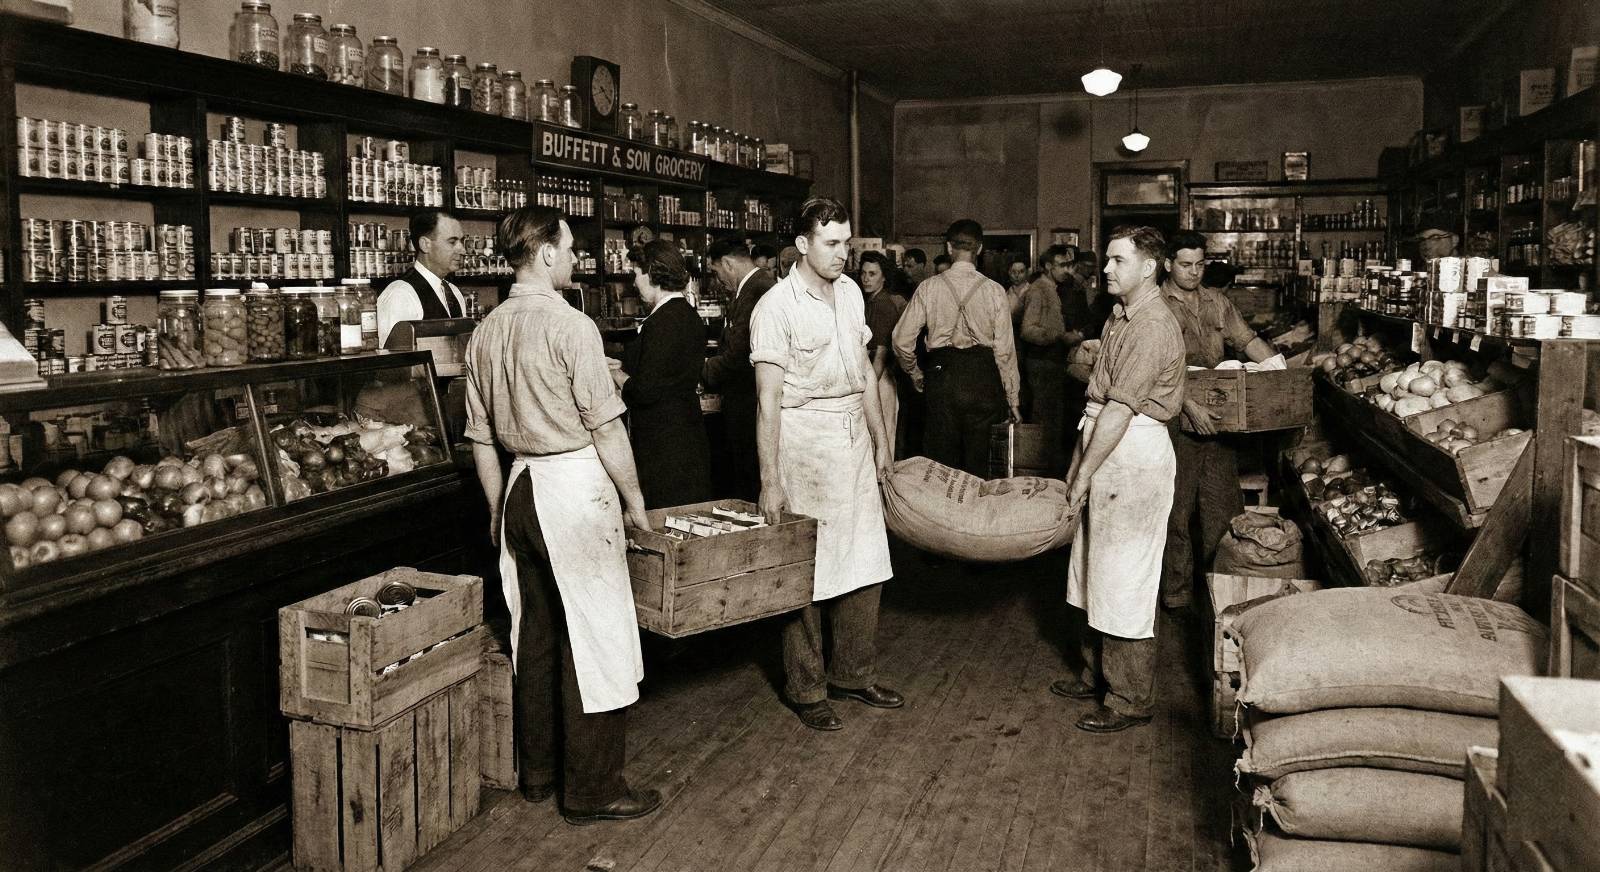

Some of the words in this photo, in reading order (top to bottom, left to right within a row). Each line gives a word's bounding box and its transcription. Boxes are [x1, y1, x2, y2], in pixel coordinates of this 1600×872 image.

[543, 131, 607, 165] BUFFETT
[612, 146, 621, 168] &
[626, 149, 650, 172] SON
[655, 154, 705, 181] GROCERY
